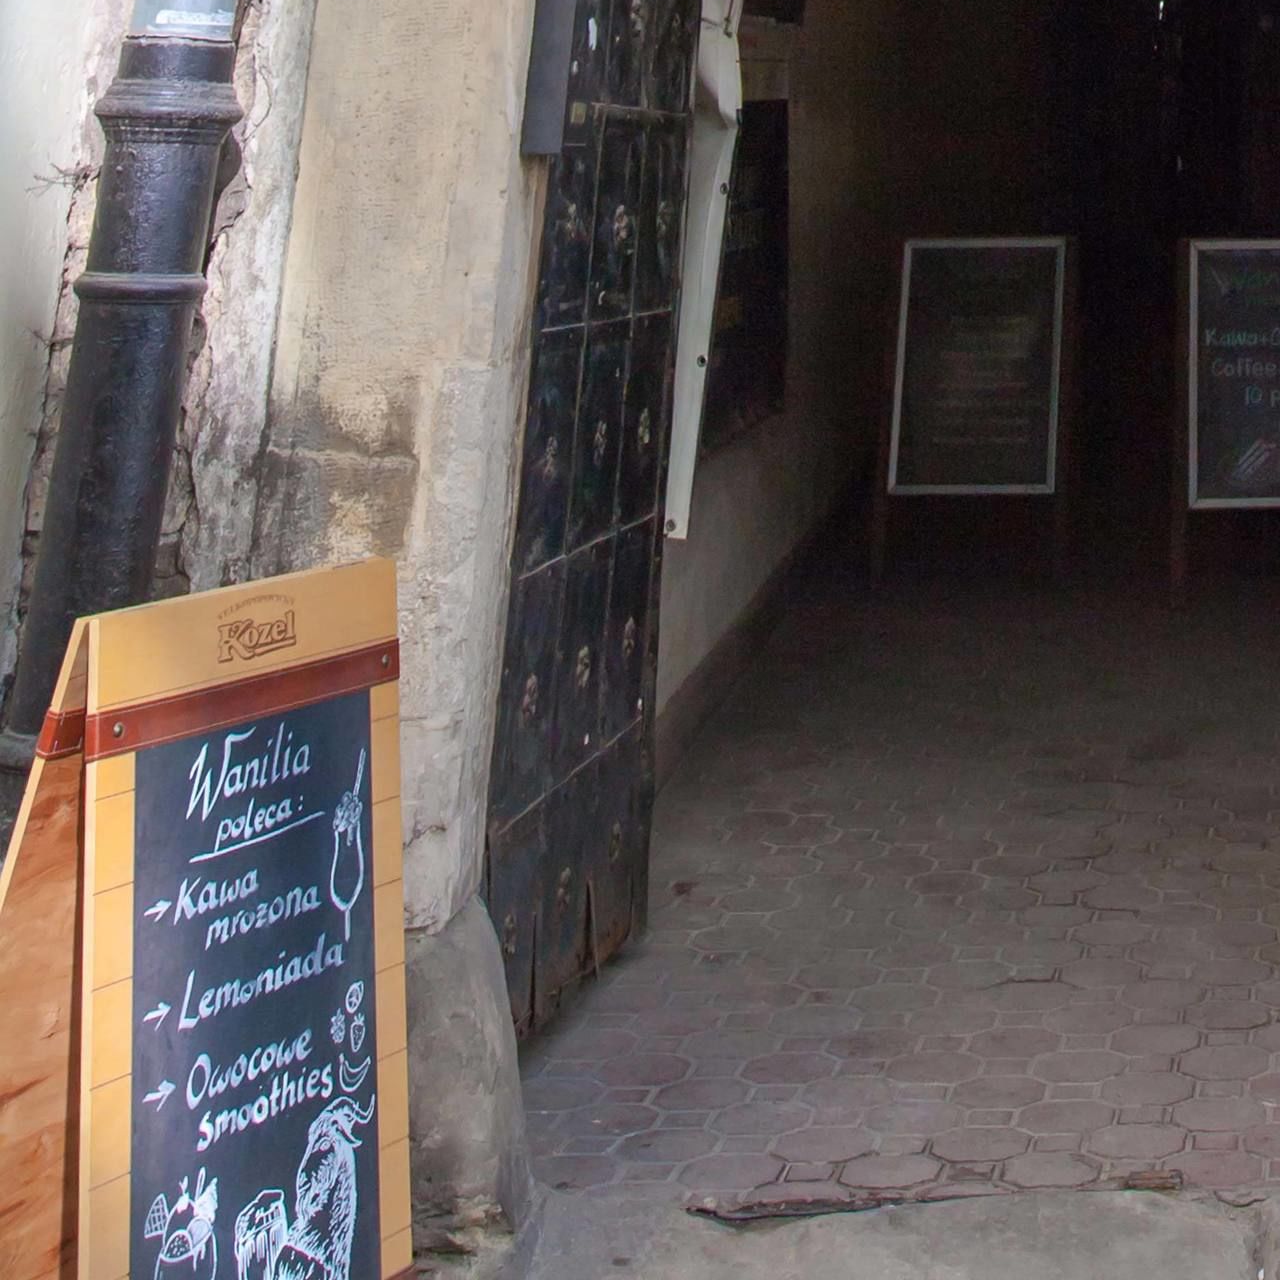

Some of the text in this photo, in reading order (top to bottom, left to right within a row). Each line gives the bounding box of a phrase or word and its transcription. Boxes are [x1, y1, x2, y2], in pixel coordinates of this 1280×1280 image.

[1244, 383, 1264, 405] 10
[217, 610, 297, 664] Kozel
[185, 721, 312, 823] Wanilia
[173, 868, 260, 926] Kawa
[177, 932, 345, 1032] Lemoniada
[186, 1028, 313, 1111] Owocowe
